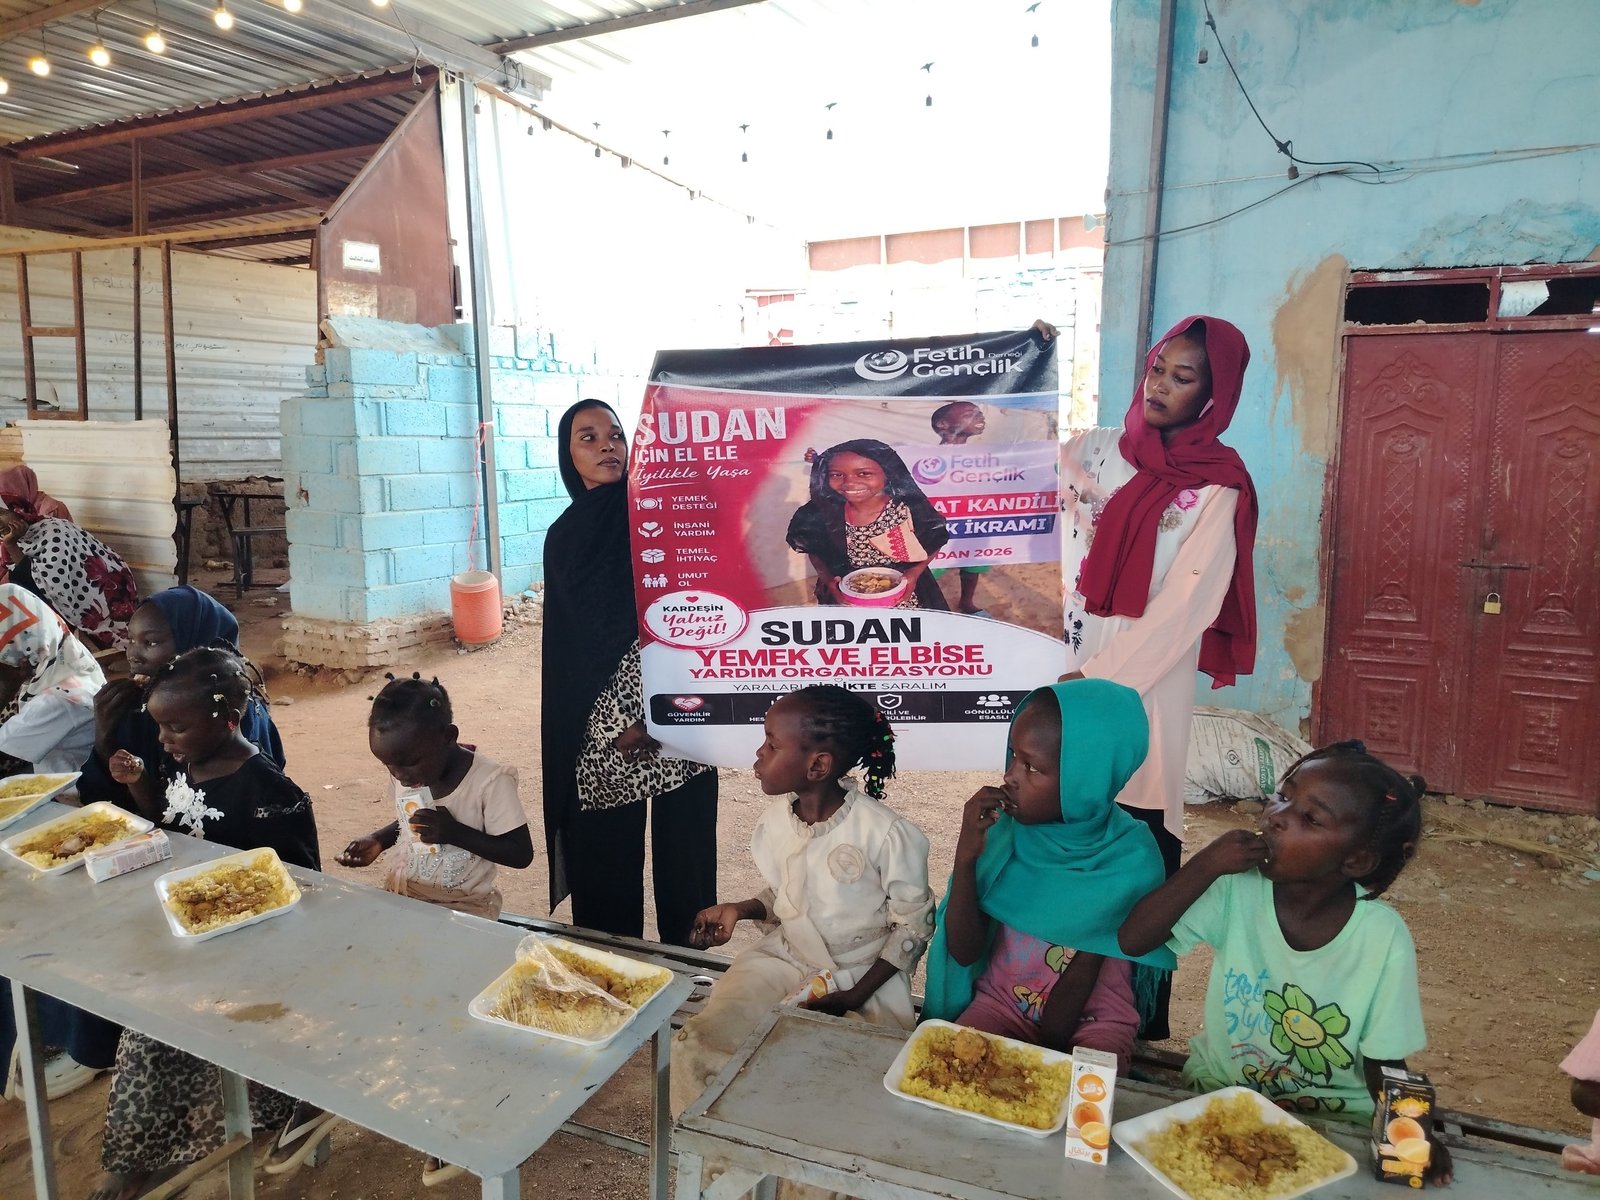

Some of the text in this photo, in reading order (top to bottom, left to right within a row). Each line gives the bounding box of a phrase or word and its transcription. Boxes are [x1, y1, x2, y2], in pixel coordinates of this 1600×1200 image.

[913, 345, 985, 363] Fetih
[912, 358, 1024, 378] Gençlik
[635, 407, 787, 446] SUDAN
[675, 447, 698, 462] EL
[703, 445, 738, 461] ELE
[951, 452, 1000, 468] Fetih
[635, 465, 752, 485] İyilikle Yaşa
[950, 467, 1026, 483] Gençlik
[672, 502, 717, 510] DESTEĞİ
[673, 521, 710, 529] İNSANİ
[674, 529, 715, 537] YARDIM
[964, 518, 1047, 534] İKRAMI
[676, 554, 718, 563] İHTİYAÇ
[935, 547, 1013, 560] DAN 2026
[663, 604, 724, 613] KARDEŞİN
[662, 613, 725, 627] Yalnız
[669, 622, 727, 640] Değil!
[760, 617, 922, 646] SUDAN
[695, 641, 984, 668] YEMEK VE ELBİSE
[689, 664, 993, 678] YARDIM ORGANİZASYONU
[733, 683, 803, 691] YARALARI
[881, 682, 947, 690] SARALIM
